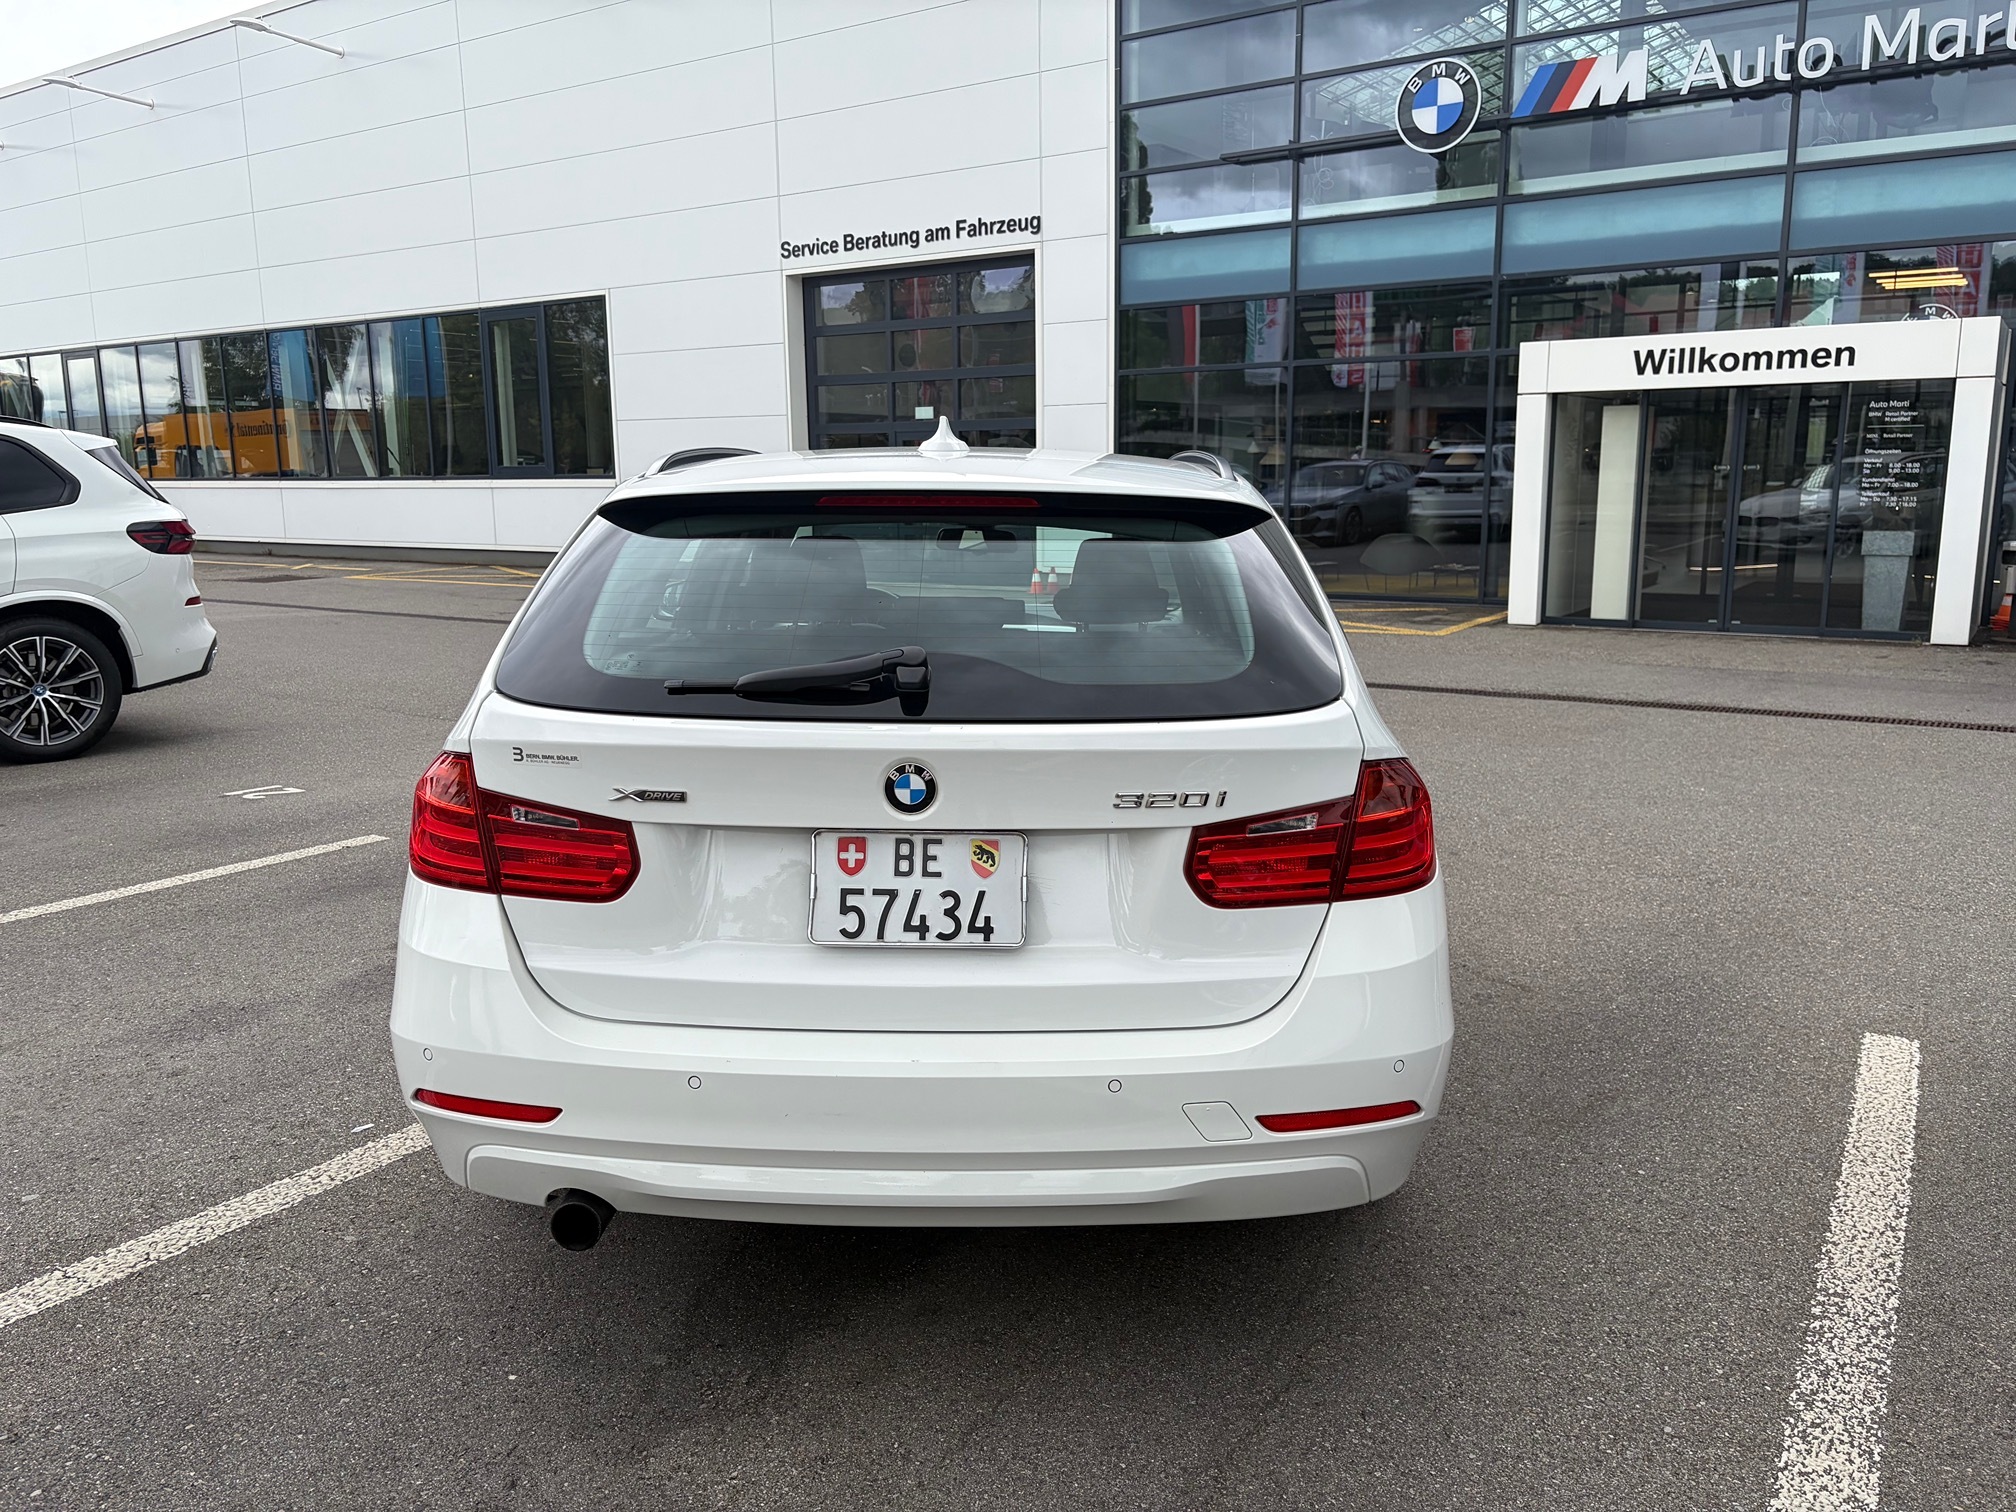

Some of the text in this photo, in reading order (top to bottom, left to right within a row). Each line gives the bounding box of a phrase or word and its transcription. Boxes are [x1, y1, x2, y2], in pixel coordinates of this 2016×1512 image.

[1407, 63, 1471, 94] BMW
[1679, 33, 1835, 96] Auto
[780, 215, 1041, 260] Service Beratung am Fahrzeug
[1633, 346, 1856, 376] Willkommen
[1889, 400, 1910, 408] Marti
[889, 764, 933, 781] BMW
[1112, 790, 1228, 809] 320i
[893, 837, 943, 878] BE
[838, 888, 995, 941] 57434
